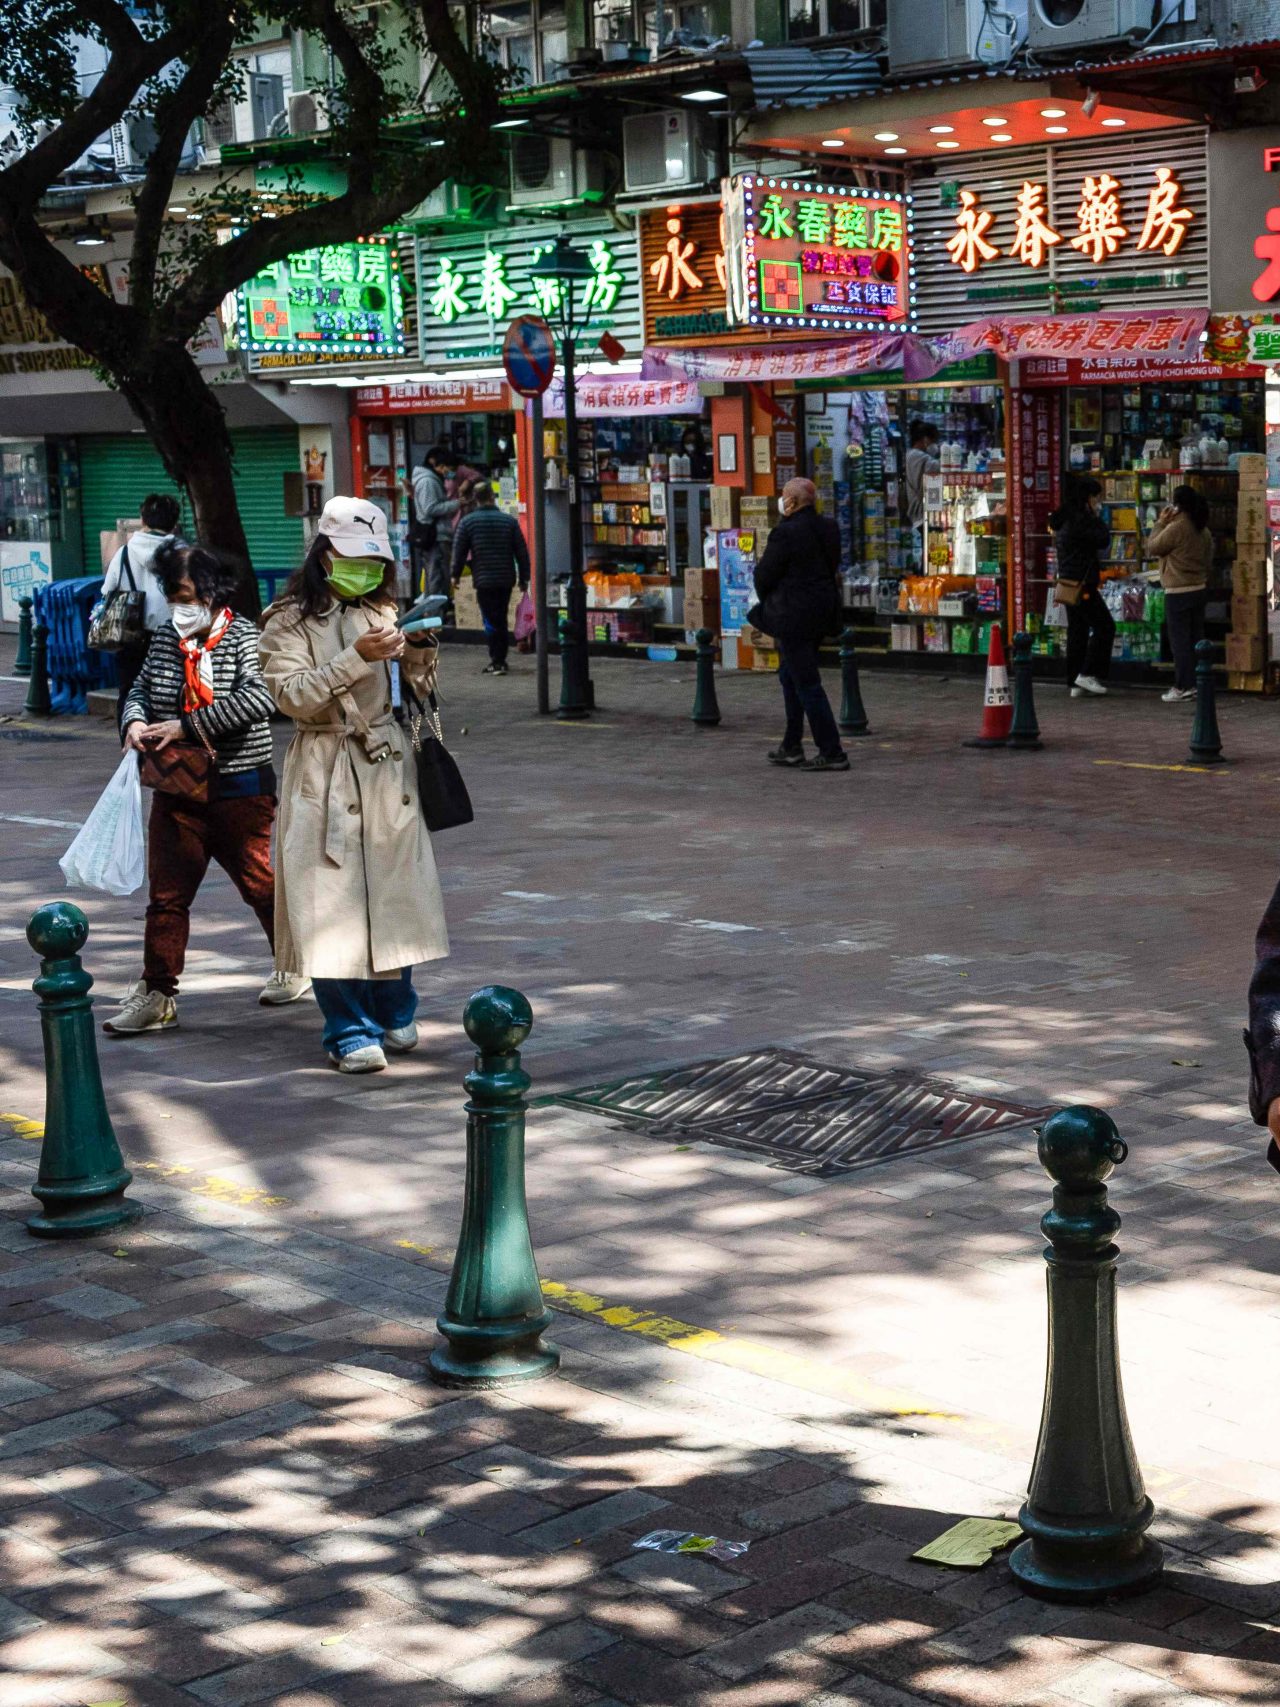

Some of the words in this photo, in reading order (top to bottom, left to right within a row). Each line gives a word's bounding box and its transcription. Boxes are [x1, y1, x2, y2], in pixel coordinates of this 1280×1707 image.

[757, 194, 903, 252] 永春藥房
[945, 167, 1194, 273] 永春藥房
[257, 248, 388, 284] 世藥房
